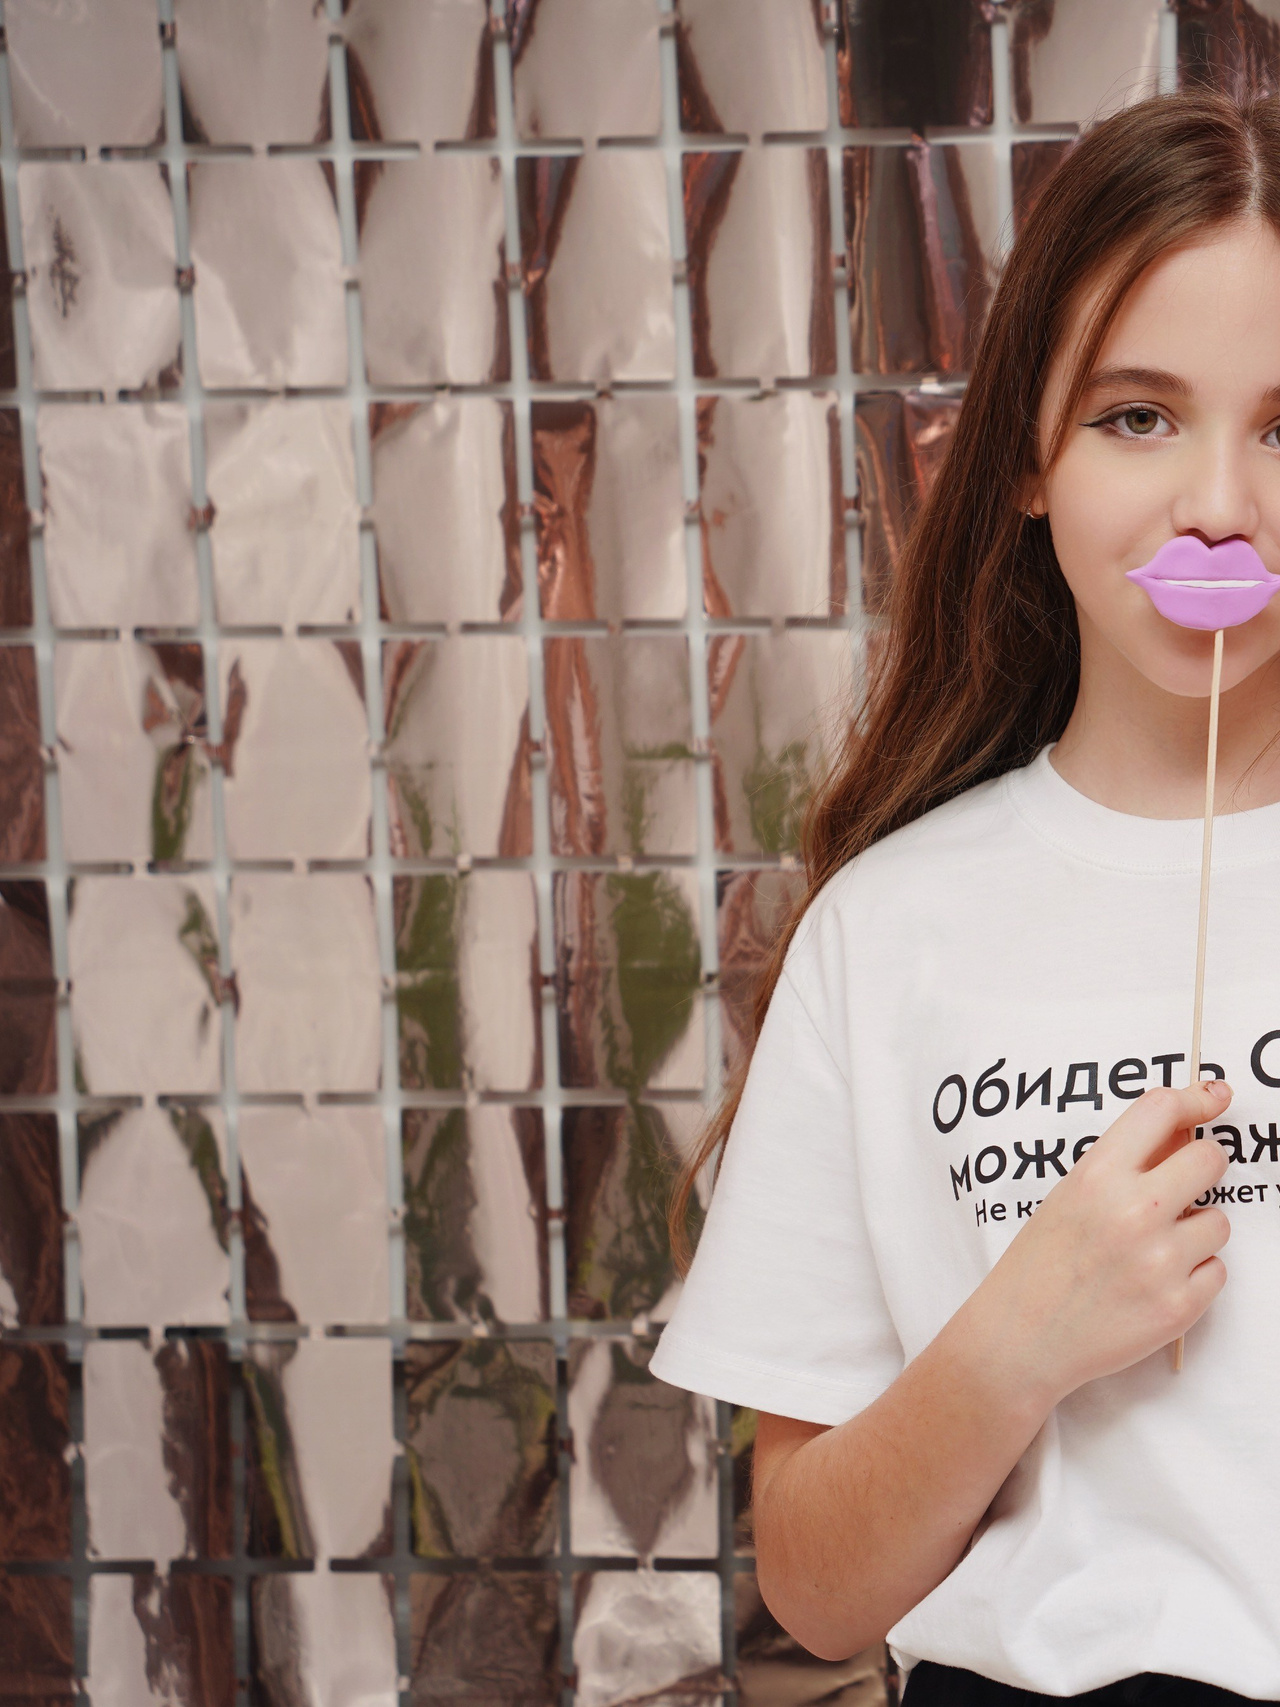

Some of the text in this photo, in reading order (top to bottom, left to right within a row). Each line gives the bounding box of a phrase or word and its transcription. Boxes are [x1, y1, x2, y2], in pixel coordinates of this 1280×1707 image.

[949, 1135, 1101, 1202] мож
[975, 1199, 1007, 1228] Не
[1194, 1184, 1268, 1207] ожет
